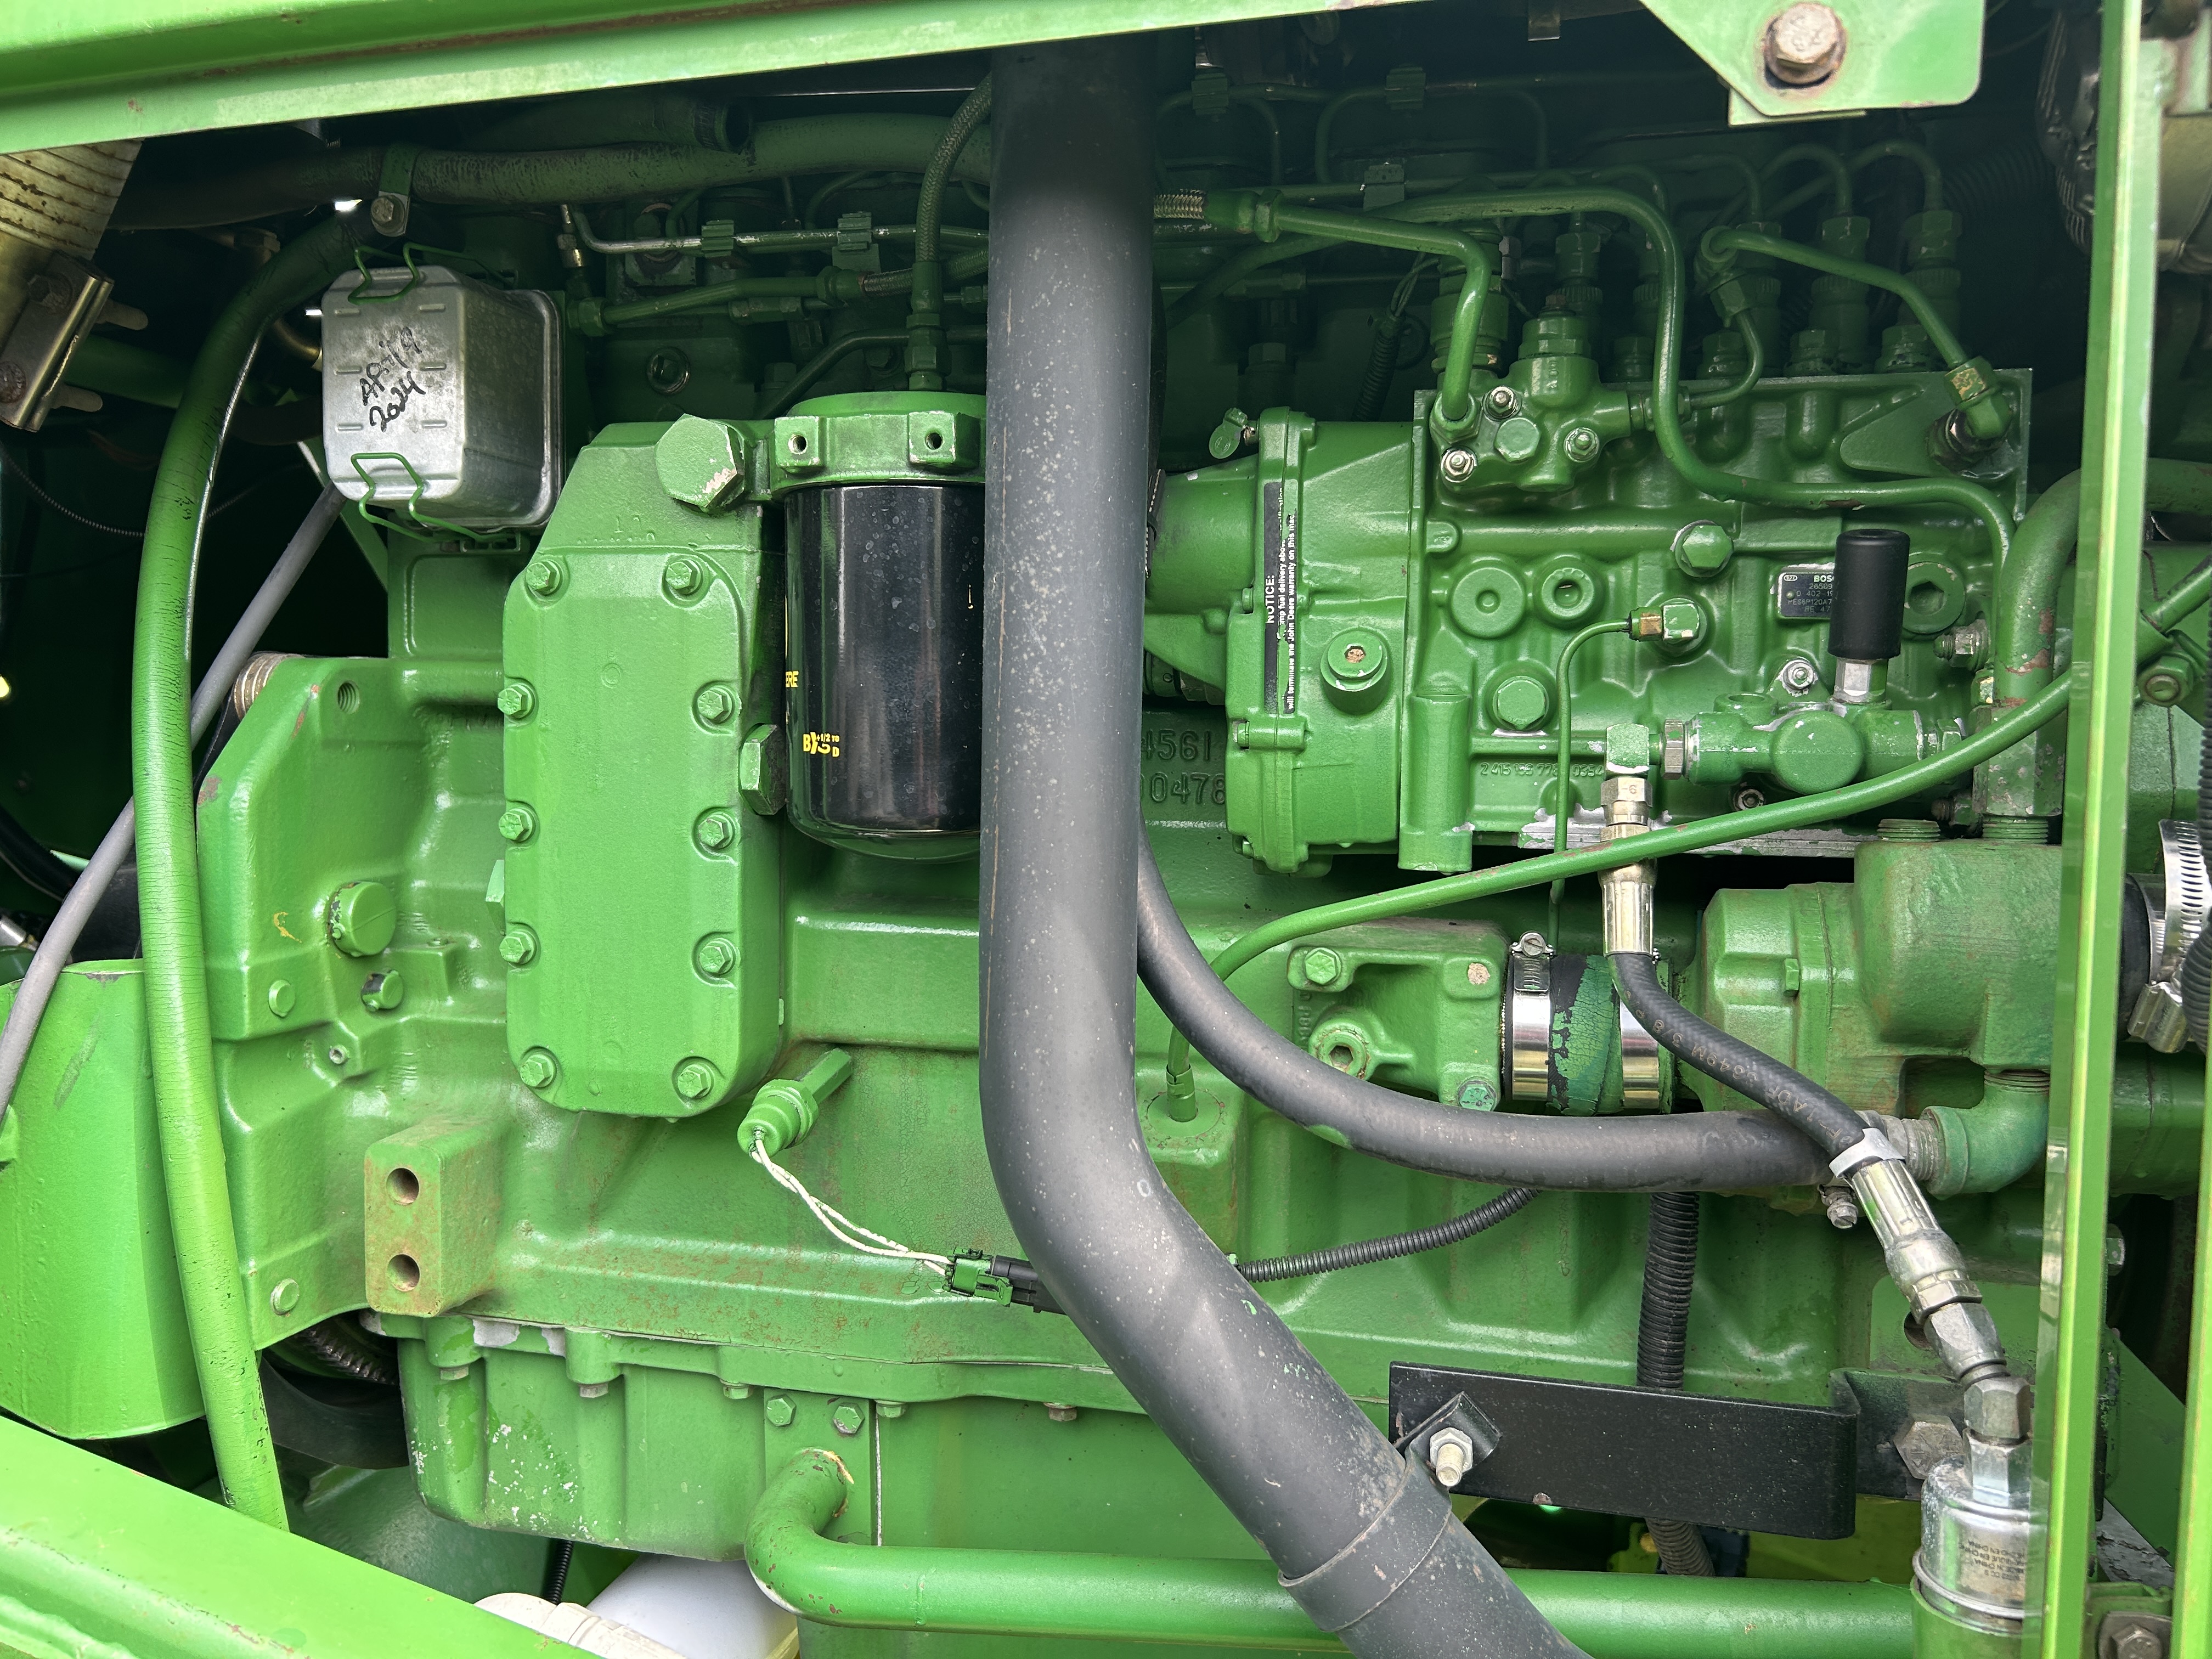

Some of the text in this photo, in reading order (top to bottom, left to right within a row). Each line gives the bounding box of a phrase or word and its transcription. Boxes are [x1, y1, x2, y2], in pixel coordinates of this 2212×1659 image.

[369, 370, 426, 432] 2024
[1289, 550, 1295, 560] on
[1278, 563, 1286, 593] delivery
[1288, 562, 1296, 596] warranty
[1265, 575, 1275, 624] NOTICE:
[1286, 623, 1295, 641] John
[816, 733, 831, 742] +1/2
[1491, 762, 1511, 776] 415
[1141, 771, 1224, 805] 0478
[1652, 1019, 1684, 1048] 3/8
